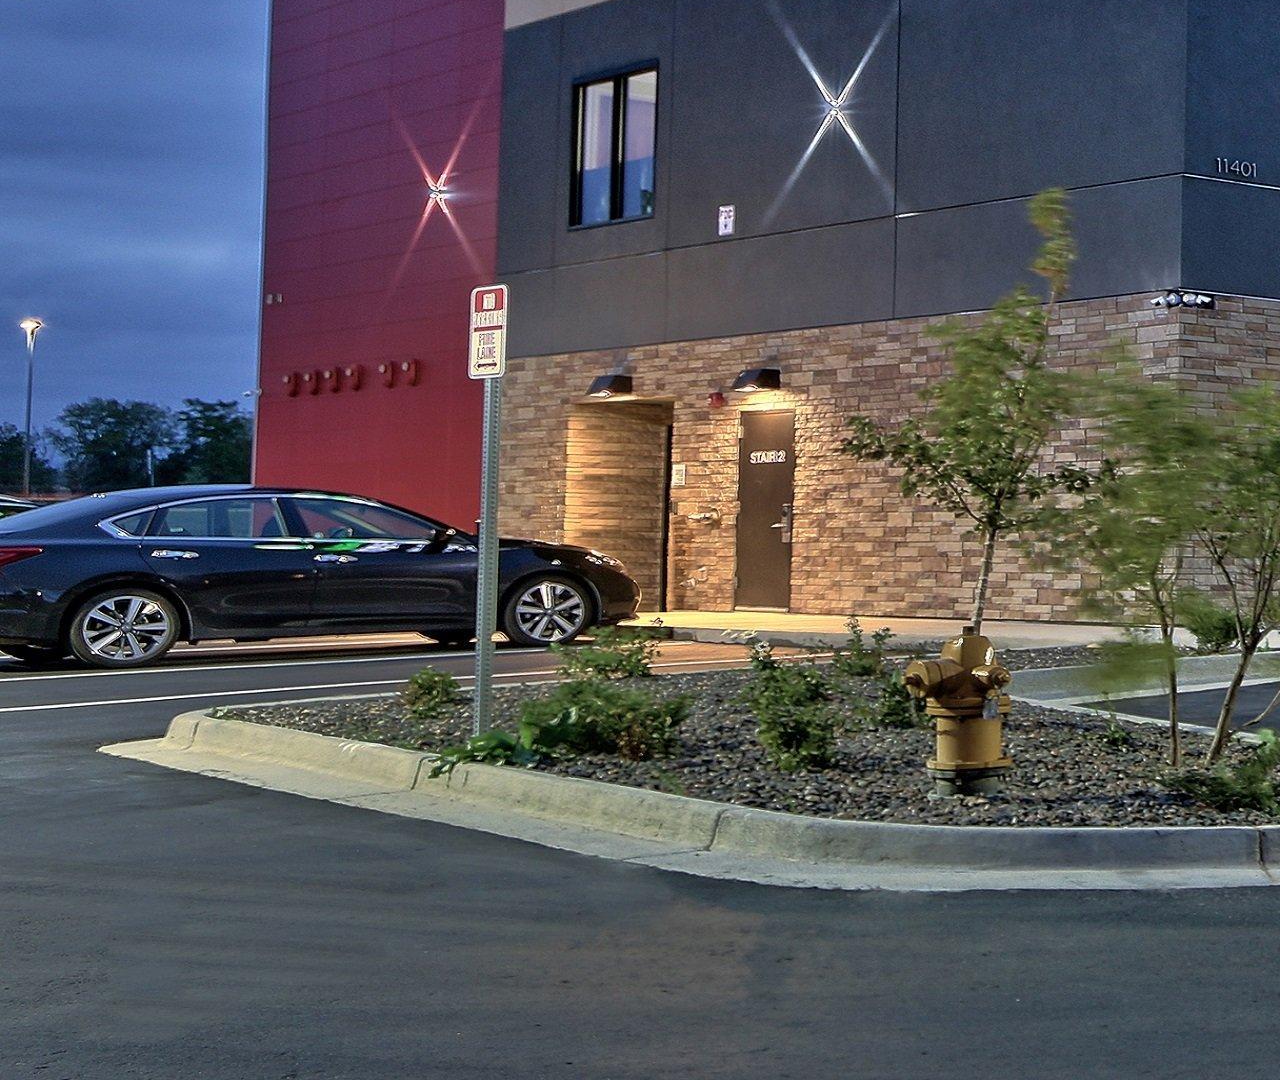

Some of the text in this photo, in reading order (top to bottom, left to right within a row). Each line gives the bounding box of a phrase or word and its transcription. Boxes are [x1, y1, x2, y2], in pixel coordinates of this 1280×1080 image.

[1216, 157, 1257, 178] 11401
[750, 450, 786, 463] STAIR 2
